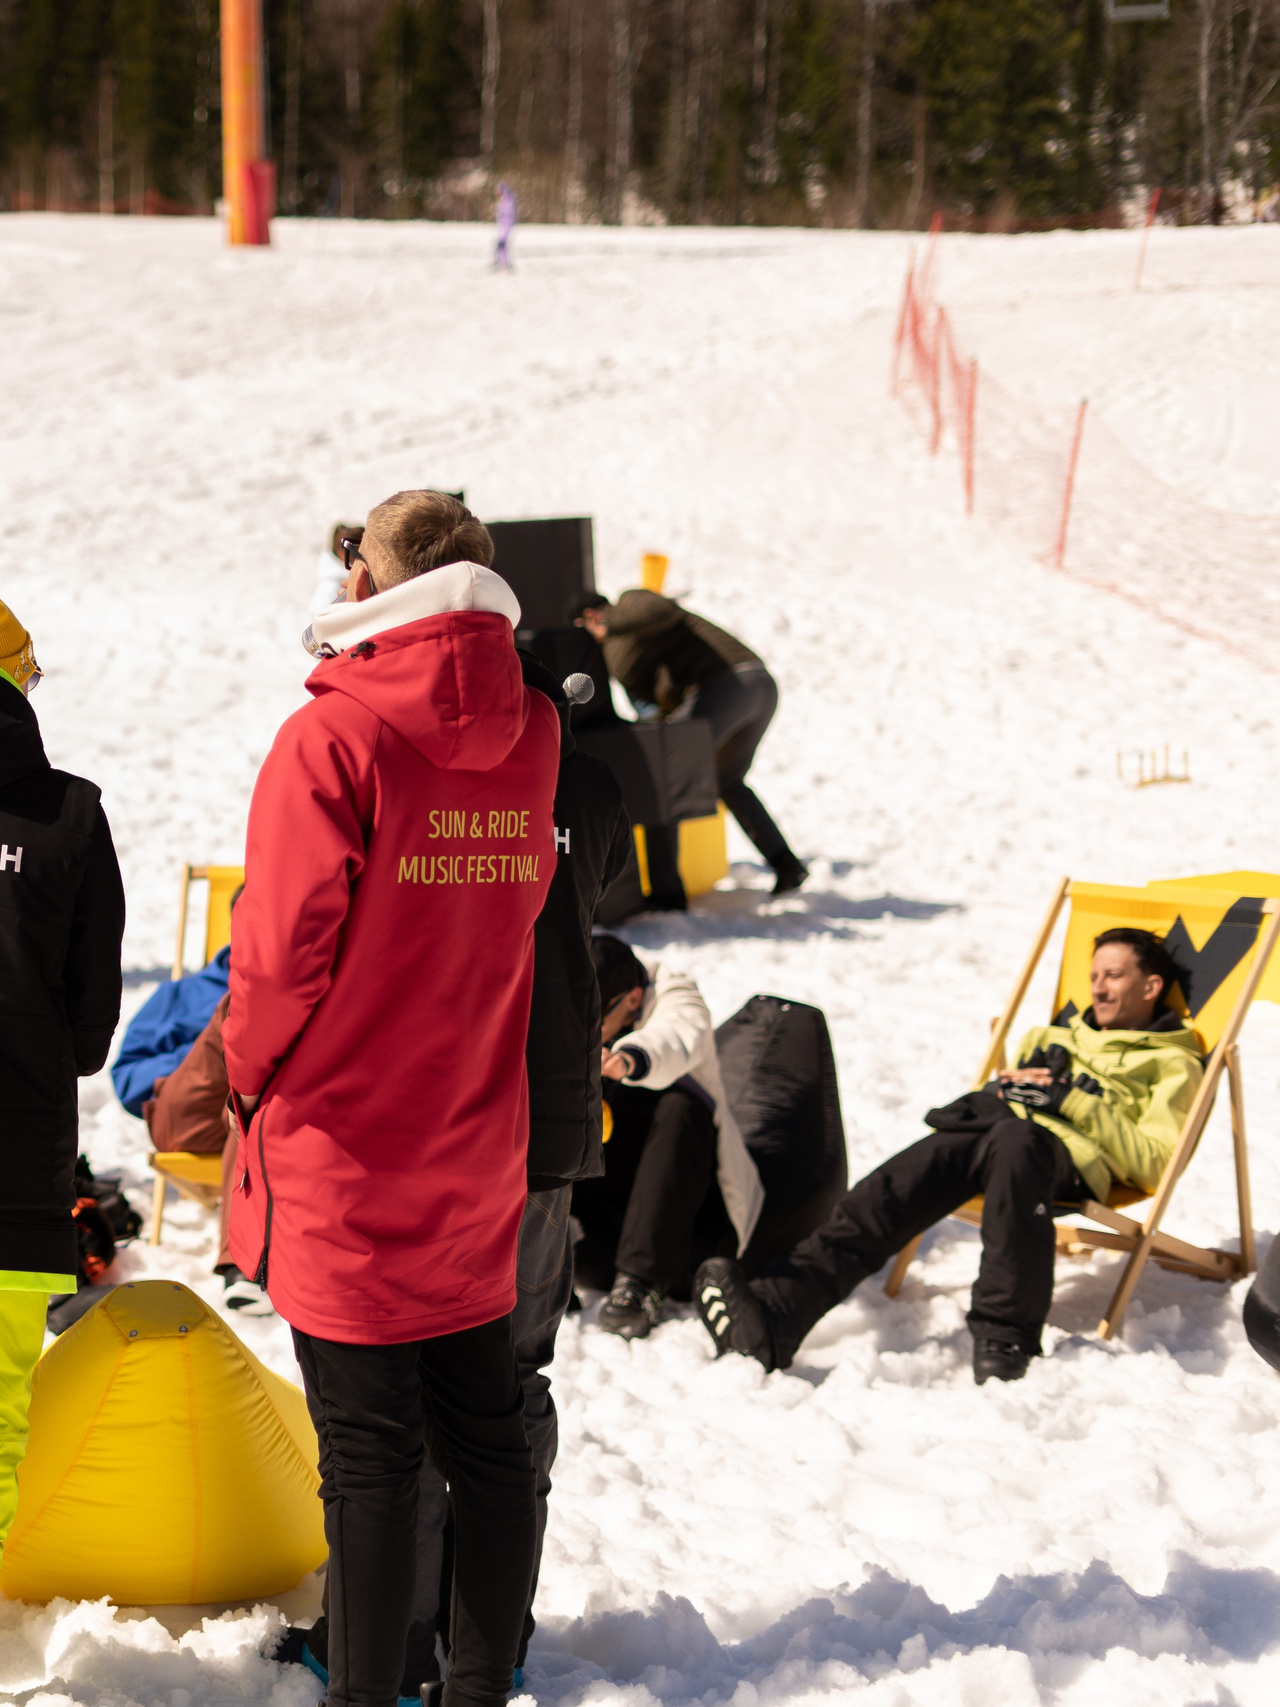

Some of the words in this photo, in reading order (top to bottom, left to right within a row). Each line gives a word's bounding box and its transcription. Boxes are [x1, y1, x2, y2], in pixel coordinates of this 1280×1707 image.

[428, 810, 466, 839] SUN
[470, 812, 483, 838] &
[487, 811, 530, 838] RIDE
[397, 855, 464, 884] MUSIC
[467, 855, 539, 883] FESTIVAL
